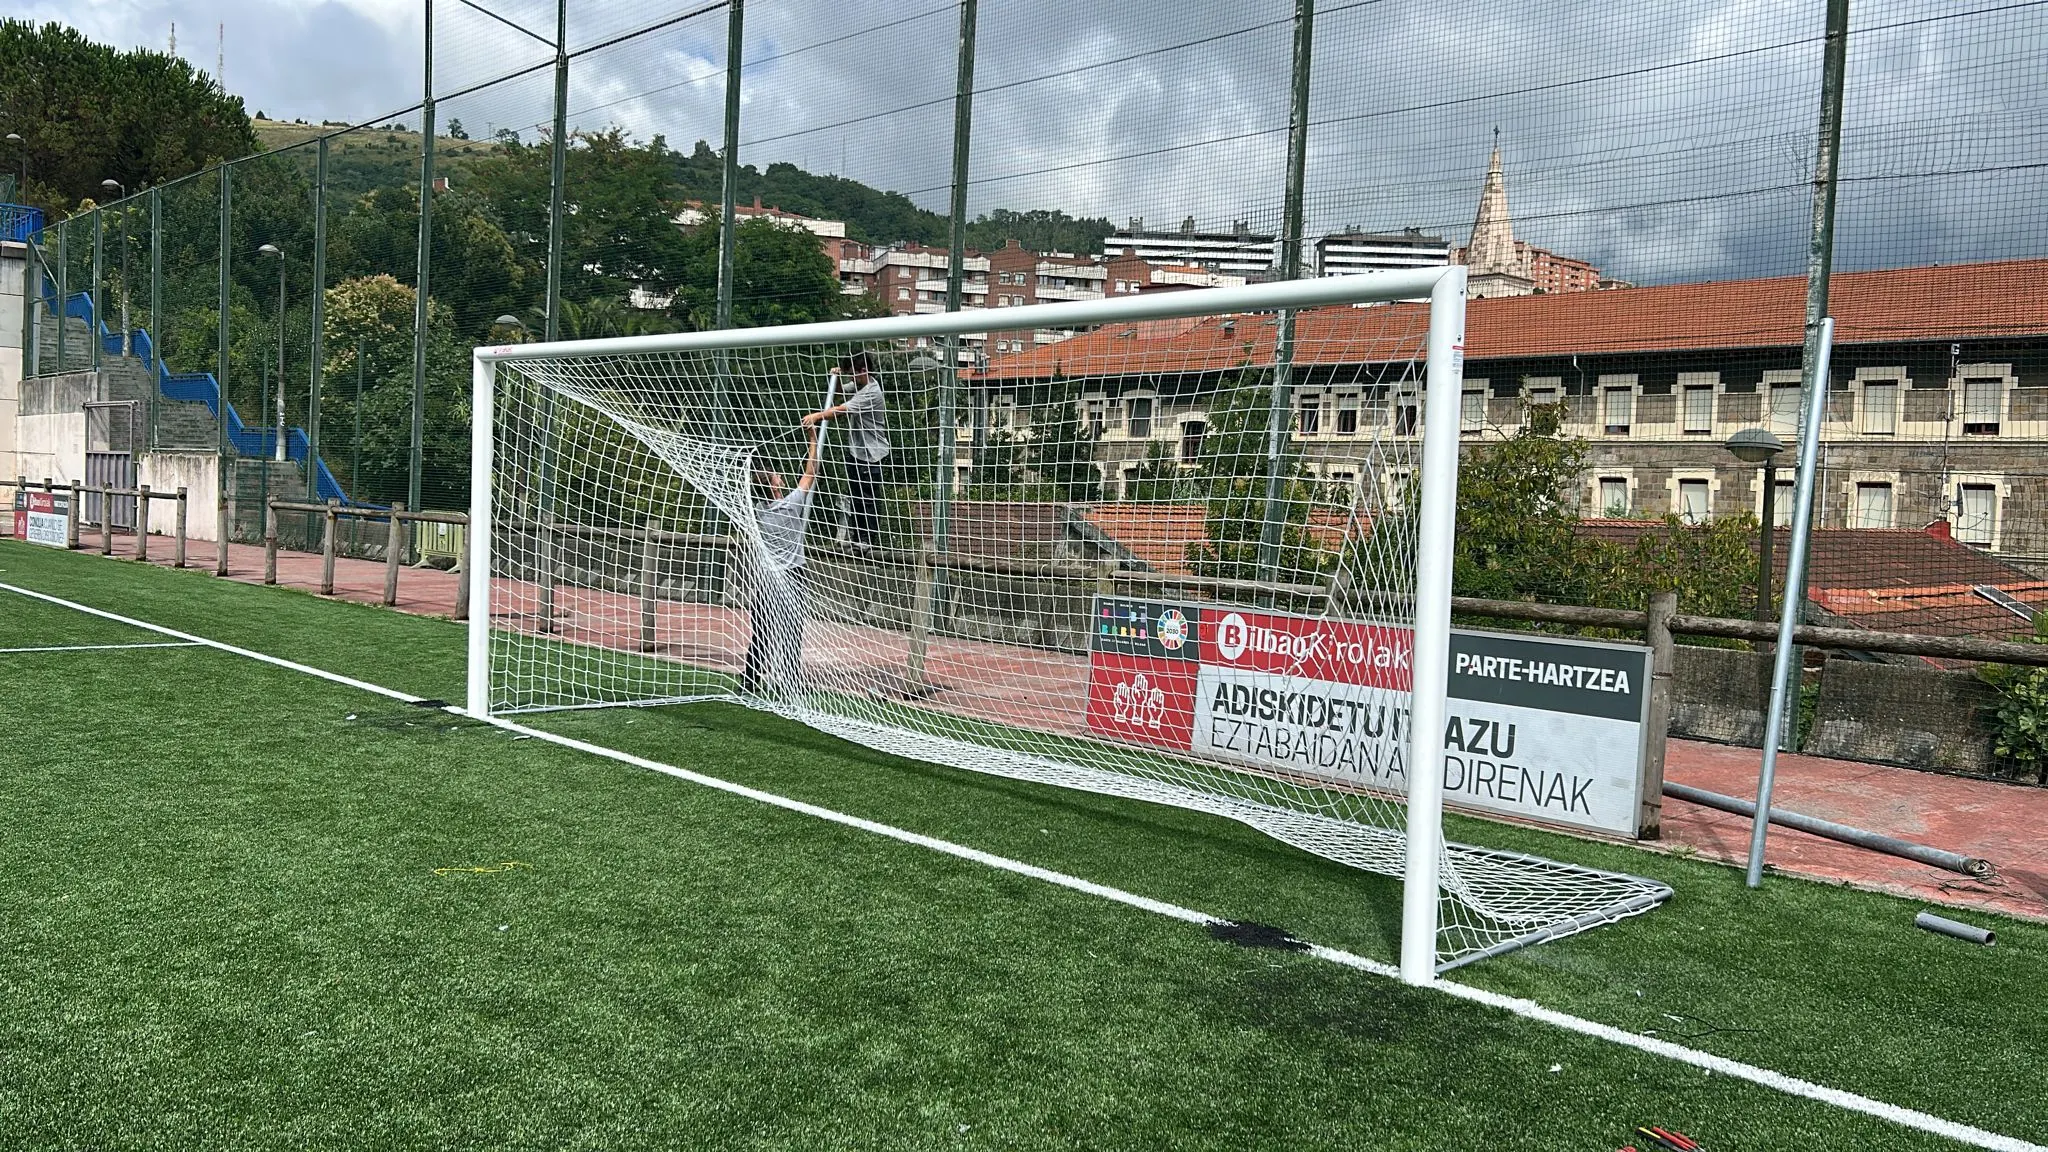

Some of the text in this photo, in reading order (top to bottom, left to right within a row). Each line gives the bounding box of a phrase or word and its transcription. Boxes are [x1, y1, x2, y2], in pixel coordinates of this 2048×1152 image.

[1455, 652, 1630, 695] PARTE-HARTZEA
[1212, 682, 1386, 739] ADISKIDETU
[1211, 717, 1379, 776] EZTABAIDAN
[1443, 755, 1593, 815] DIRENAK
